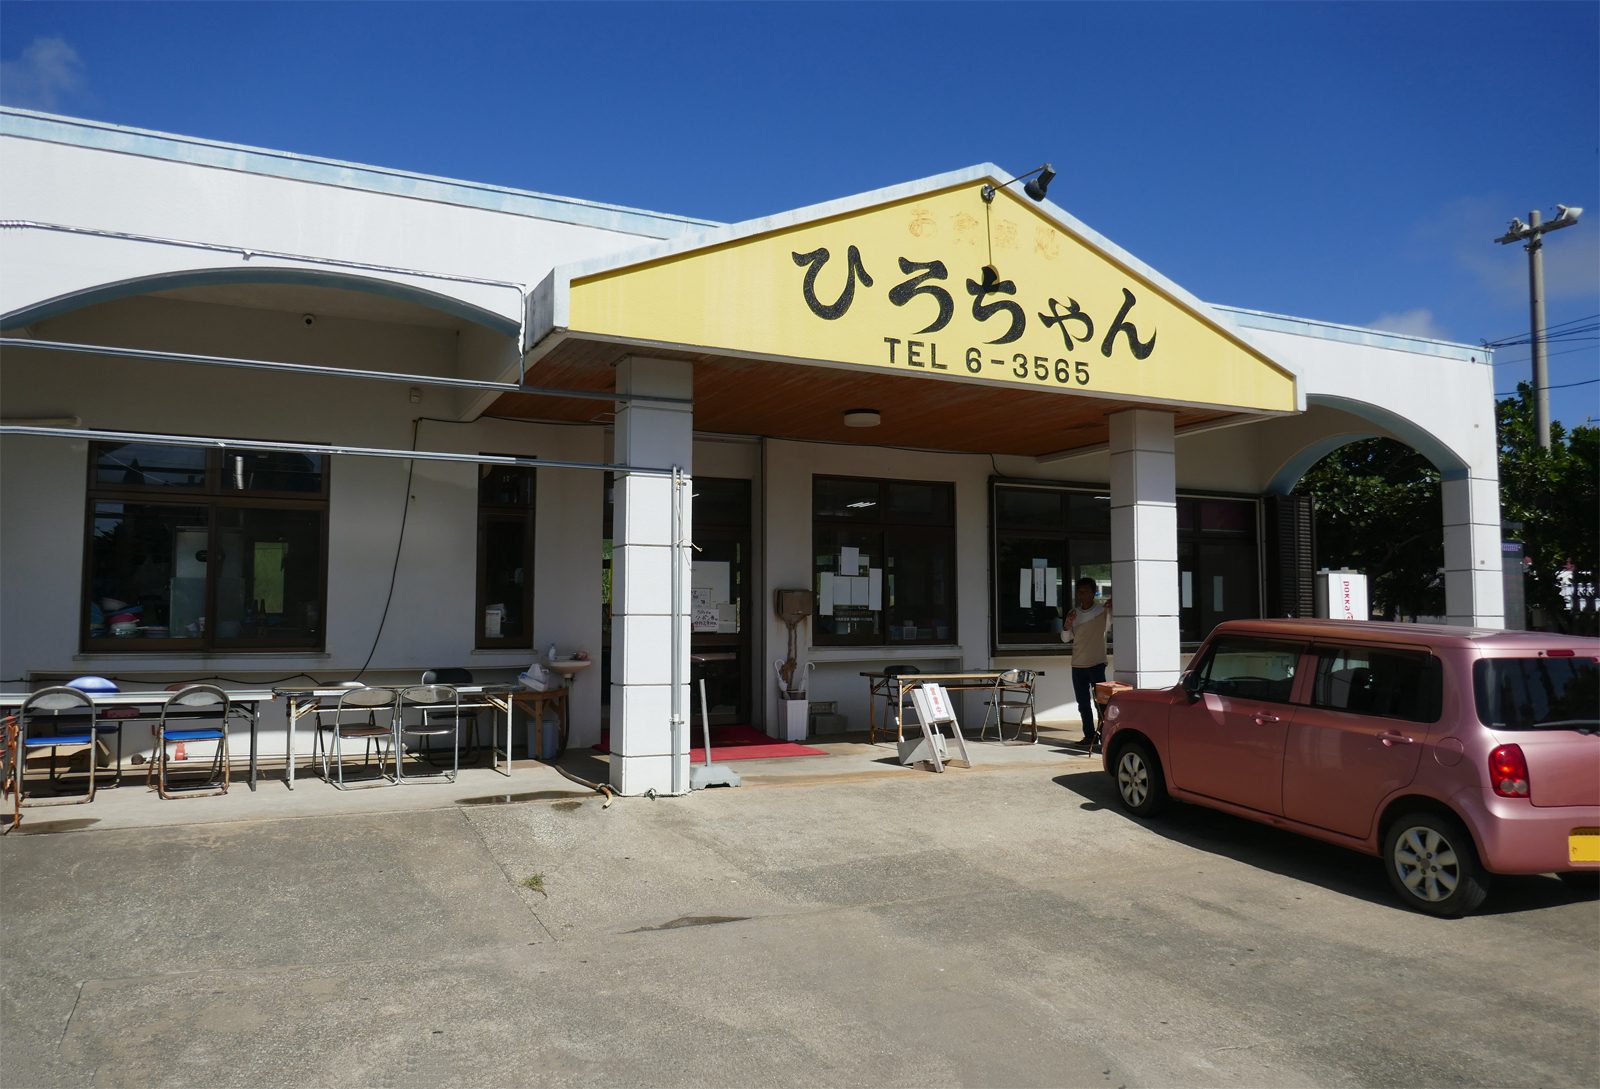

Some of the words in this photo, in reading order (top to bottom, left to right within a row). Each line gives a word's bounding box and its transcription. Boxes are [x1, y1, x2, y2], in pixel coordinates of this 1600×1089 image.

[791, 244, 1157, 361] ひろちゃん
[883, 336, 948, 370] TEL
[965, 347, 1090, 386] 6-3565
